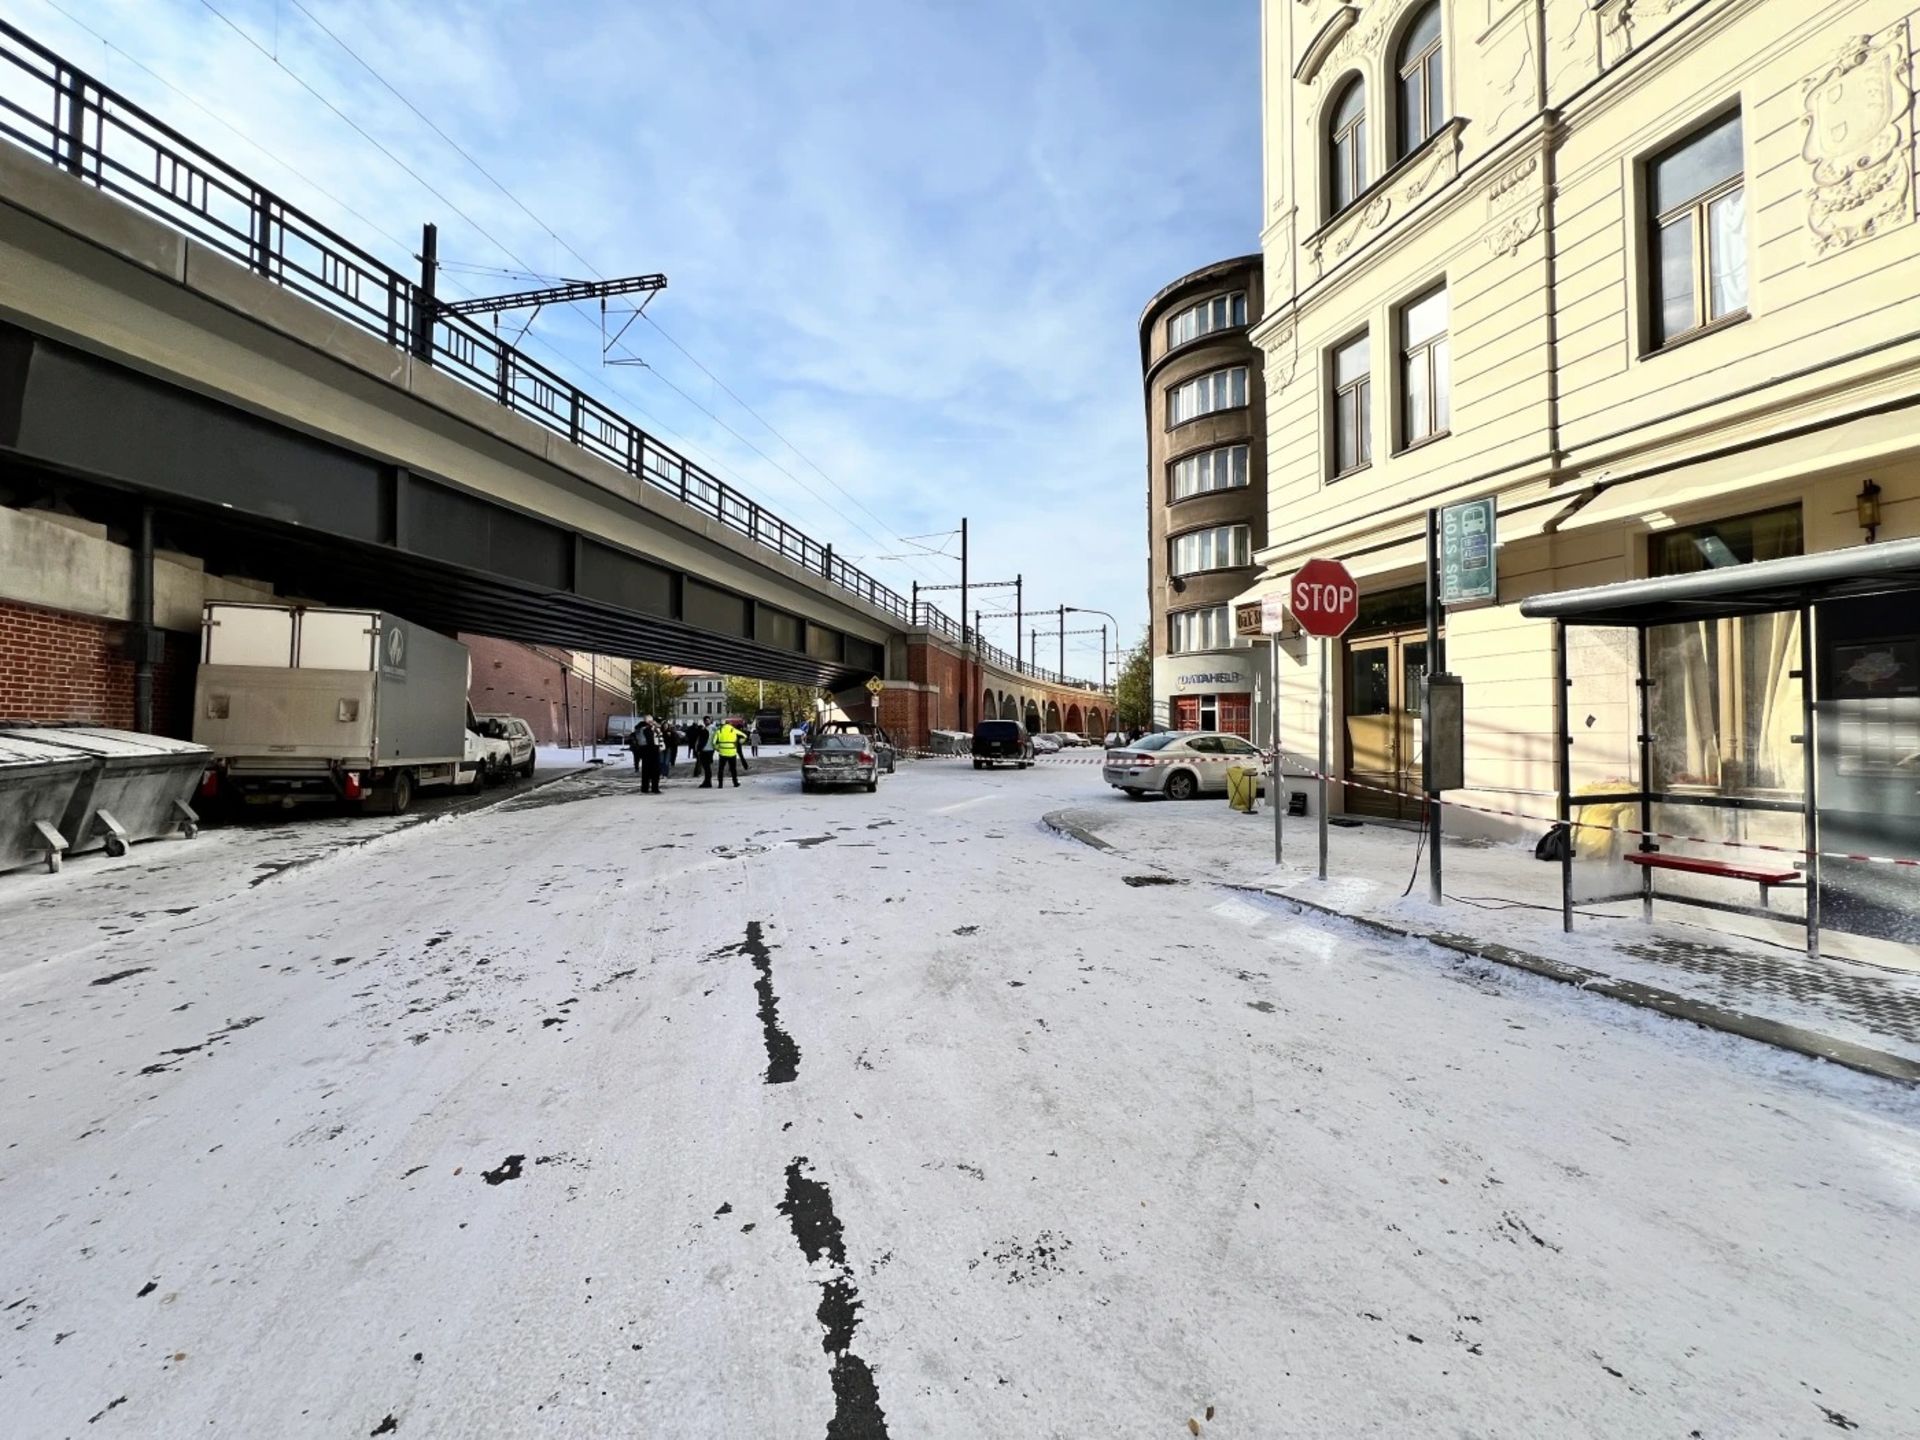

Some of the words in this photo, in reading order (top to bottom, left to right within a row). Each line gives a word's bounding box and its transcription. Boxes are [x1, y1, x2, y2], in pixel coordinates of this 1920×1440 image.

[1445, 513, 1458, 555] STOP
[1446, 563, 1459, 596] BUS
[1295, 582, 1353, 614] STOP
